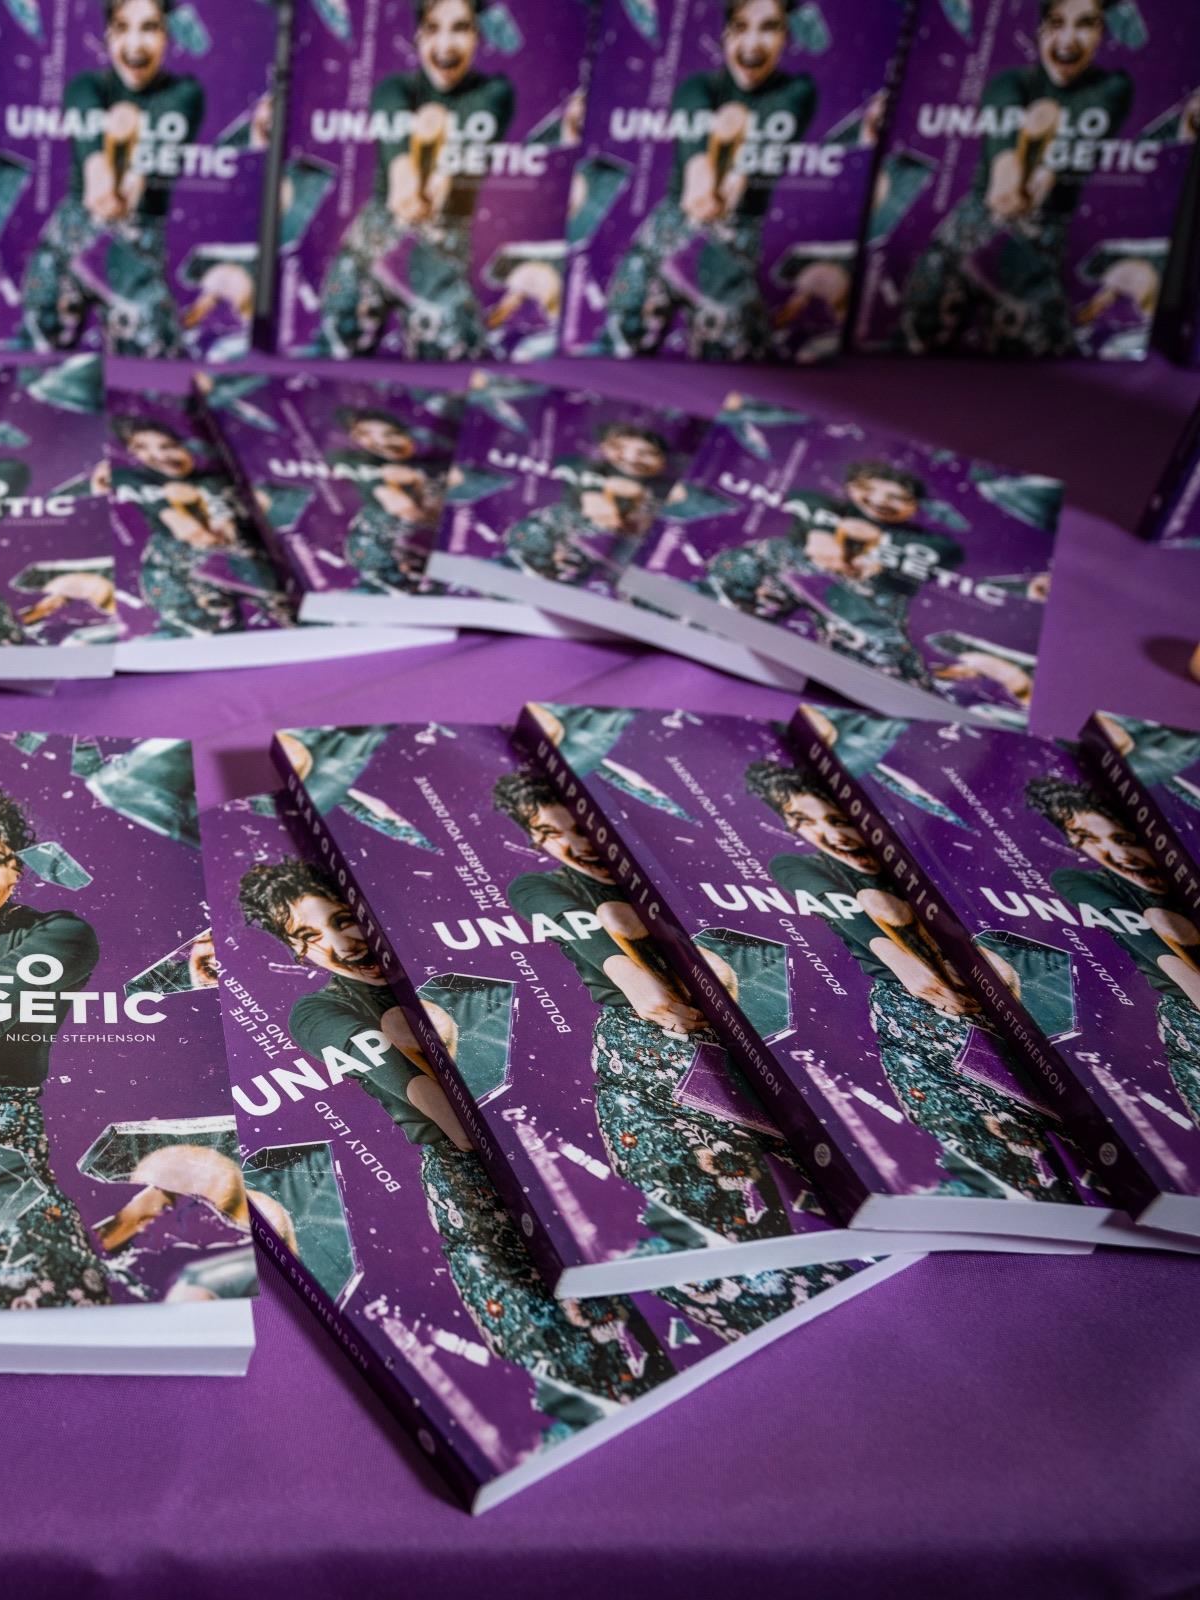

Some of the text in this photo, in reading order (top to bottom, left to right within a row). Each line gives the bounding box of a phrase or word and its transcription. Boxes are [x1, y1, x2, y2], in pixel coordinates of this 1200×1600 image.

[131, 143, 239, 178] GETIC
[437, 142, 549, 176] GETIC
[732, 143, 845, 175] GETIC
[1042, 139, 1160, 172] GETIC
[288, 773, 391, 969] UNAPOLOGETIC
[413, 775, 510, 909] AND CAREER YOU DESERVE
[537, 742, 661, 922] UNAPOLOGETIC
[746, 858, 773, 882] AND
[808, 742, 940, 922] UNAPOLOGETIC
[454, 865, 492, 911] THE LIFE
[510, 950, 572, 1034] BOLDLY LEAD
[778, 917, 848, 997] BOLDLY LEAD
[1062, 927, 1135, 1008] BOLDLY LEAD
[6, 1032, 157, 1043] NICOLE STEPHENSON
[224, 976, 269, 1022] CAREER
[229, 1006, 280, 1060] THE LIFE
[266, 1024, 298, 1050] AND
[691, 965, 782, 1096] NICOLE STEPHENSON
[970, 965, 1067, 1096] NICOLE STEPHENSON
[418, 1019, 493, 1161] NICOLE STEPHENSON
[314, 1100, 401, 1193] BOLDLY LEAD
[290, 1268, 369, 1370] STEPHENSON
